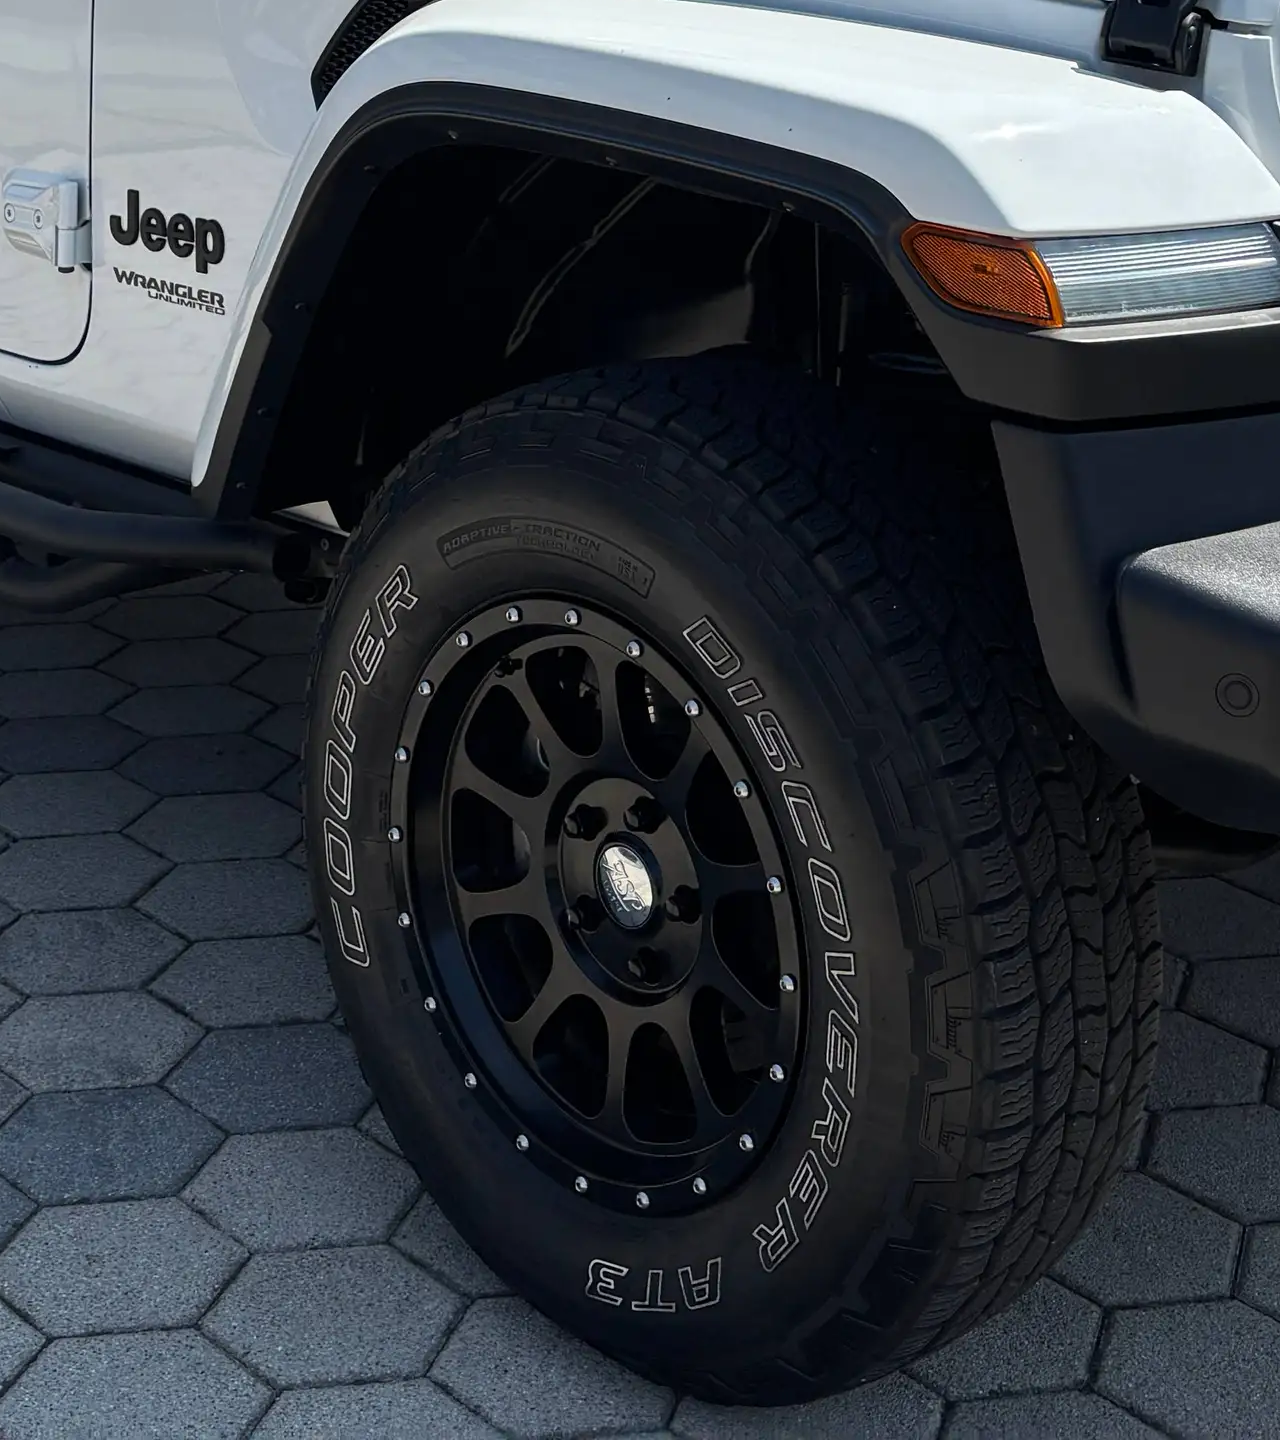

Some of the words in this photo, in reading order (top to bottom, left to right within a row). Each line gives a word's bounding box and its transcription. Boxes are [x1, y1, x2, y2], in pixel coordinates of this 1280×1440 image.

[109, 188, 226, 275] Jeep
[113, 266, 226, 309] WRANGLER
[147, 290, 226, 316] UNLIMITED
[319, 563, 420, 970] COOPER
[682, 614, 861, 1273] DISCOVERER
[585, 1255, 722, 1313] AT3
